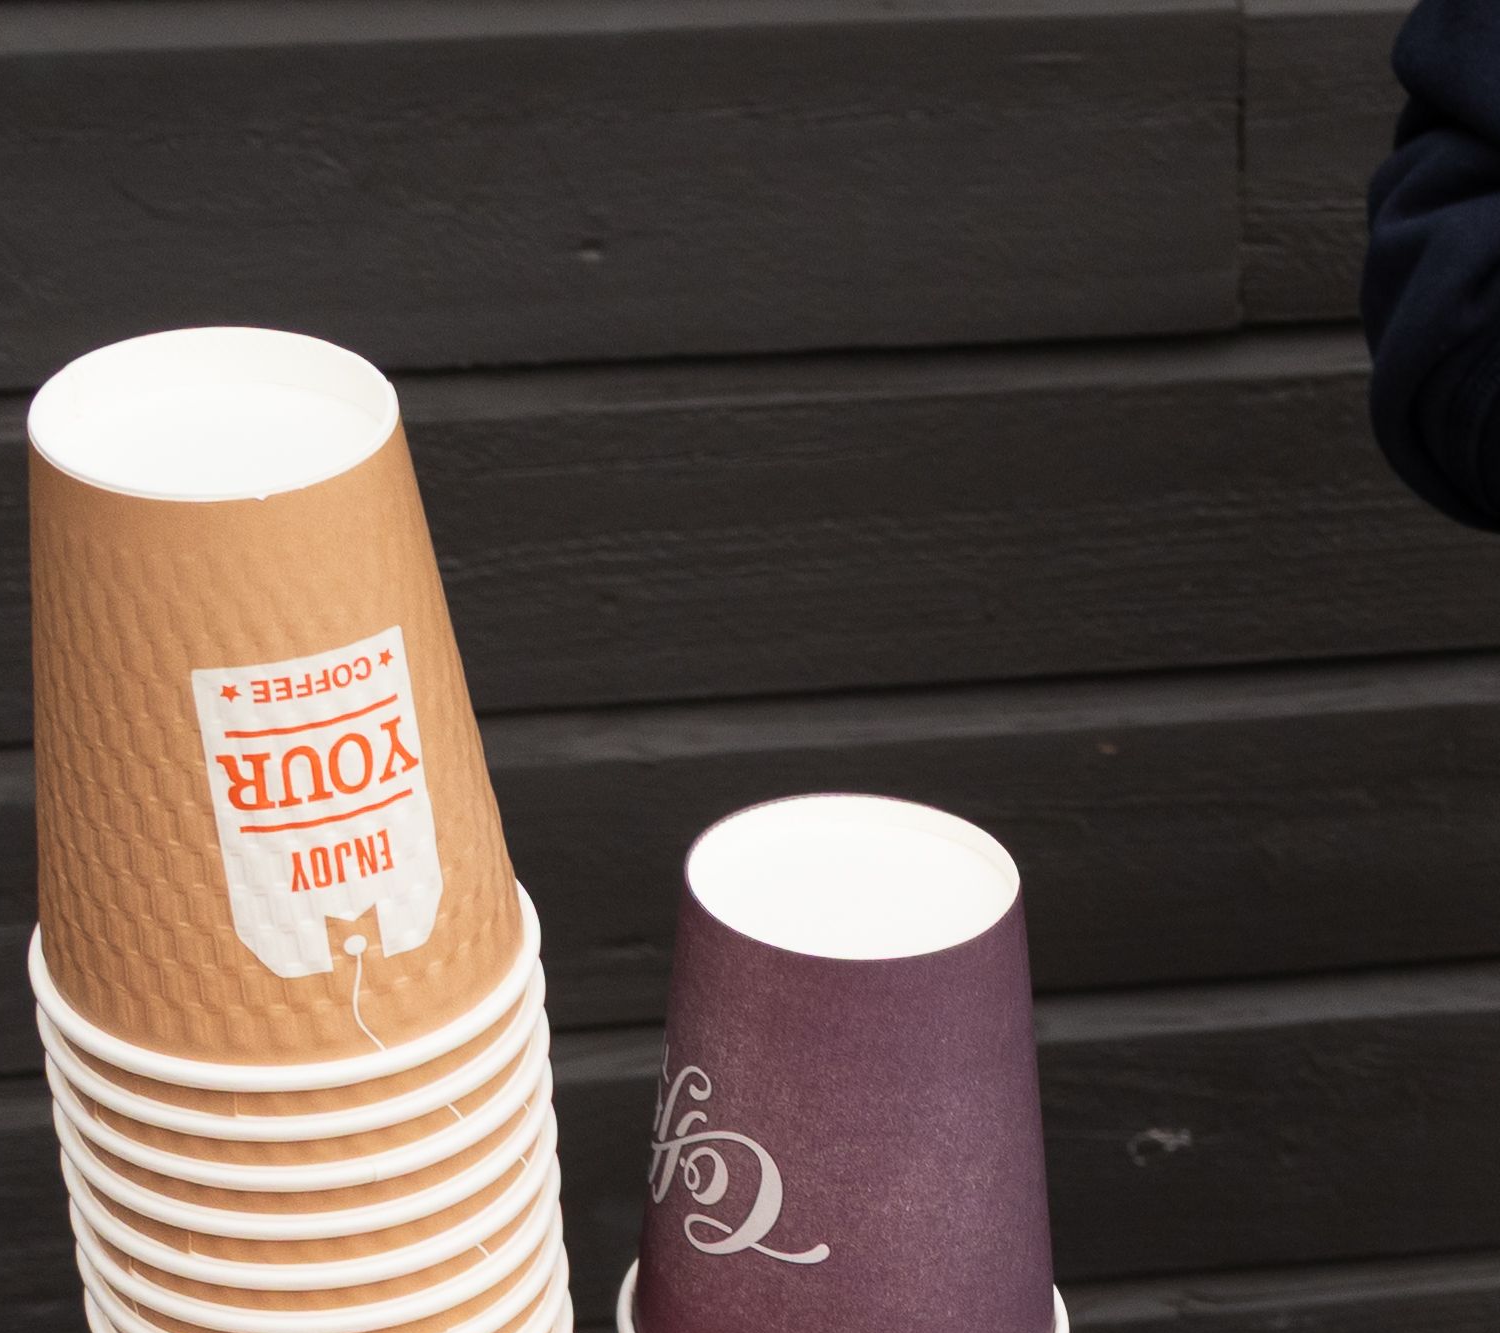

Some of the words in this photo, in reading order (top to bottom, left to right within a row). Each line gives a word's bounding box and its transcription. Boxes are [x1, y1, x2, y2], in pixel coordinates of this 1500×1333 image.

[250, 656, 372, 704] COFFEE
[215, 715, 420, 812] YOUR
[290, 828, 395, 893] ENJOY
